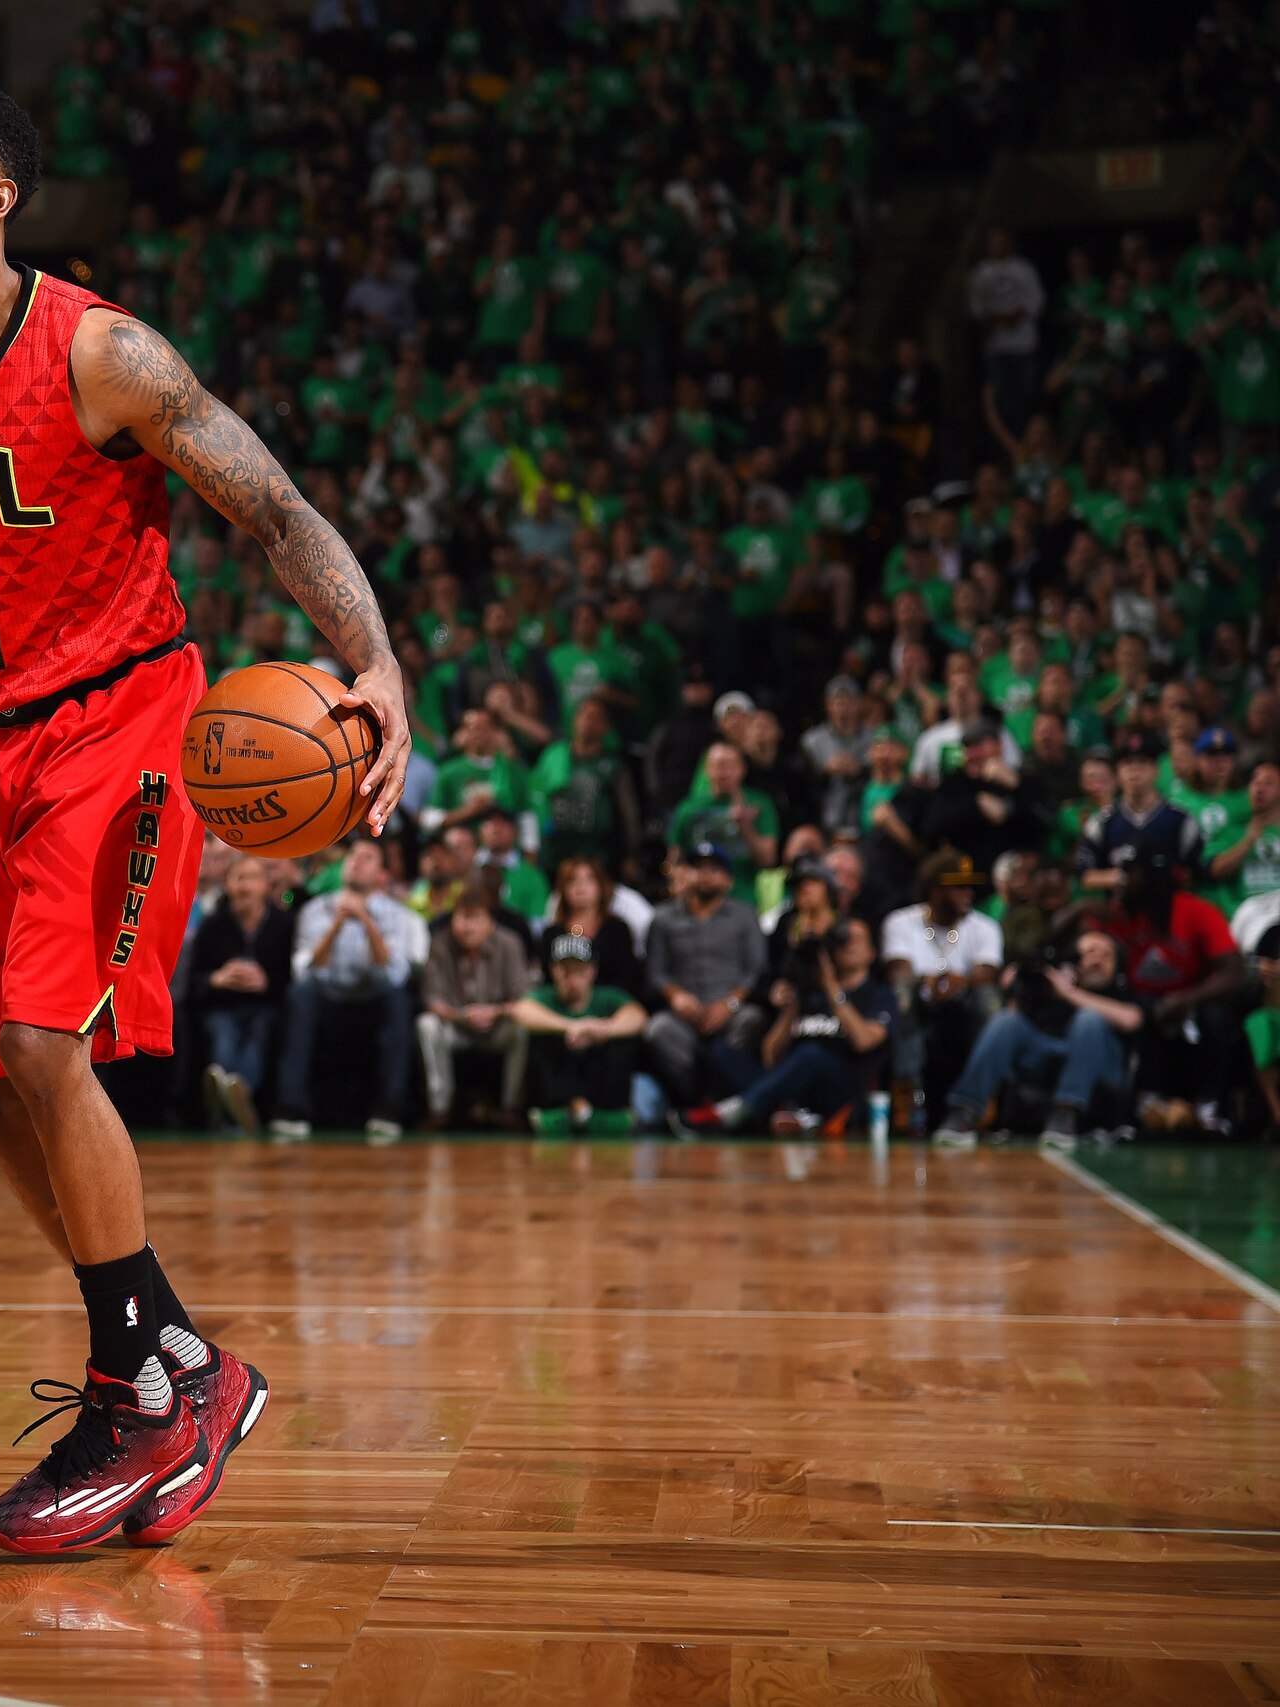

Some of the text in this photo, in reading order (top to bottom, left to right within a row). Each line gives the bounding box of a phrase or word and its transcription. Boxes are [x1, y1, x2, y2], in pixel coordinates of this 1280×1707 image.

[225, 746, 237, 757] BALL
[238, 747, 251, 759] GAME
[111, 770, 167, 966] HAWKS
